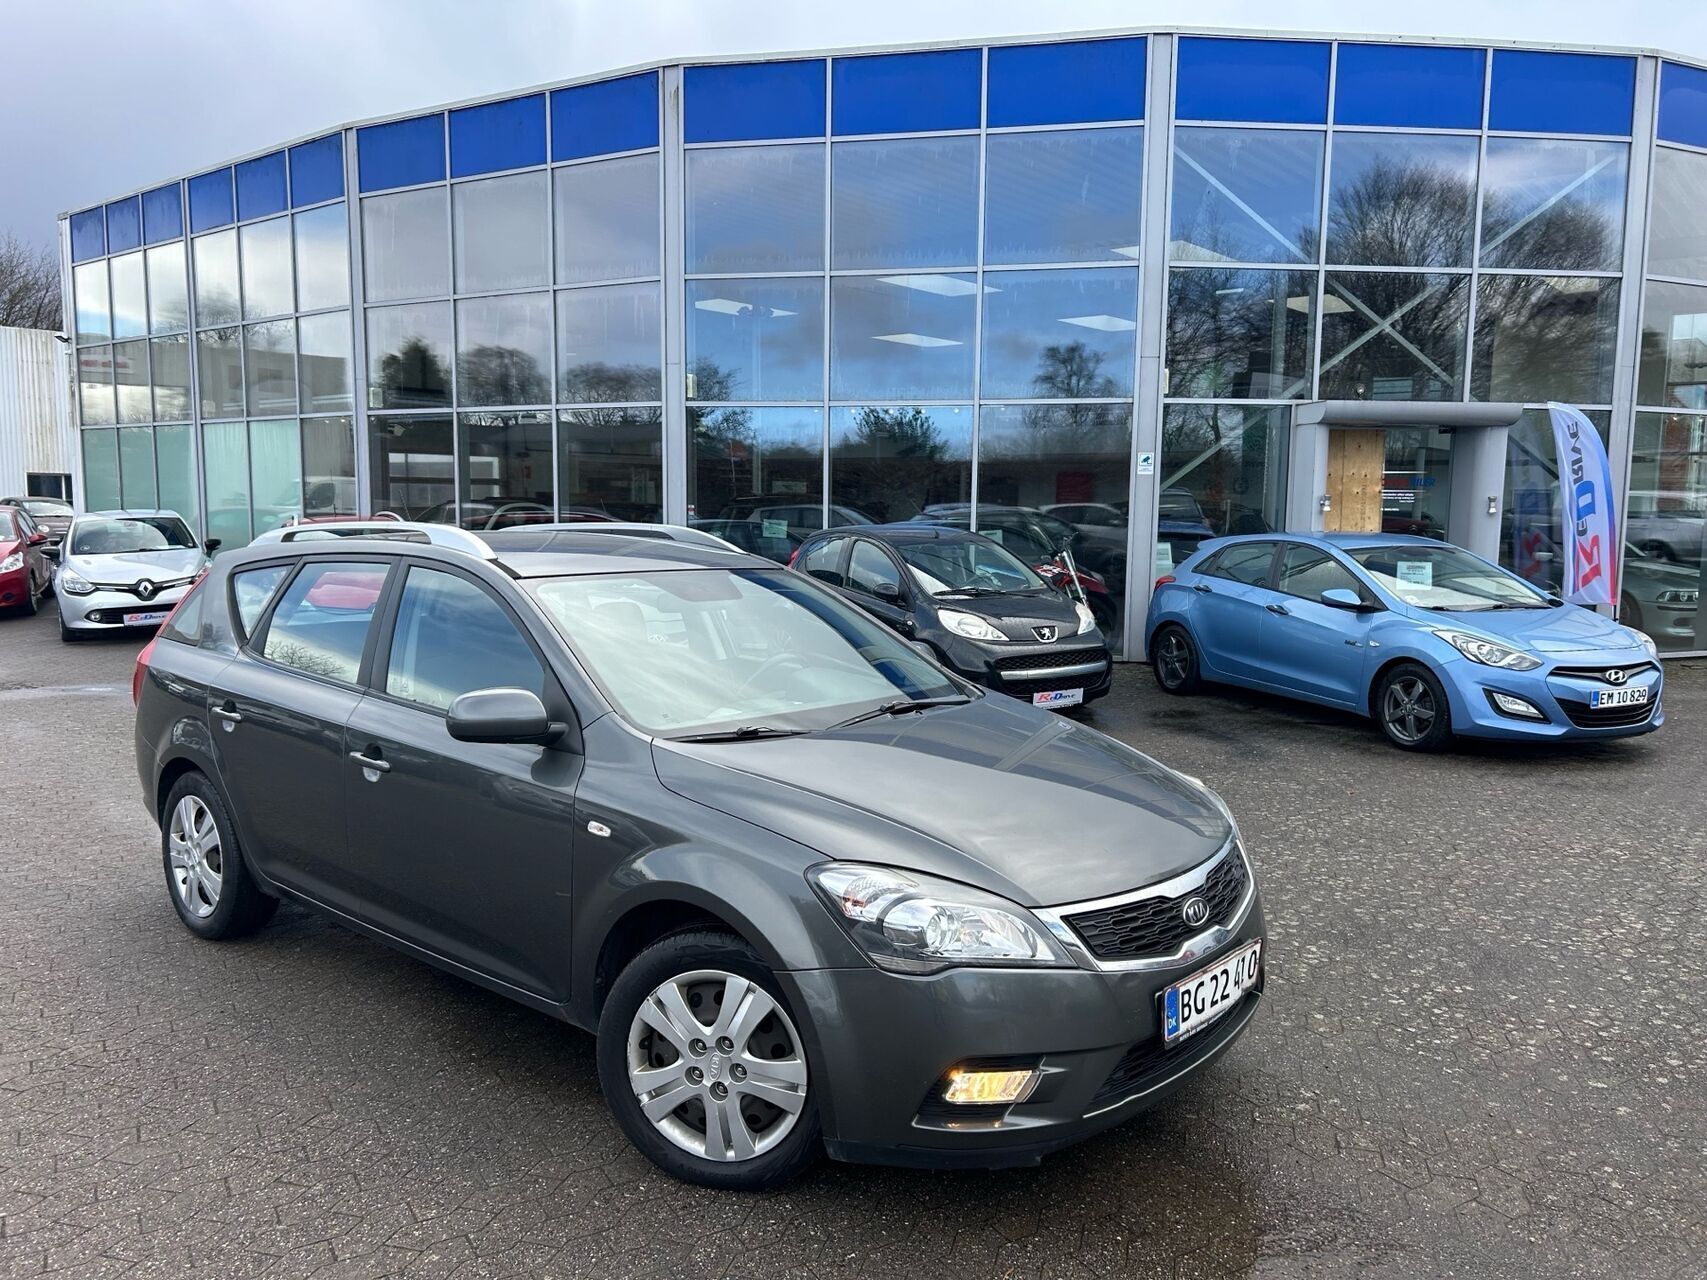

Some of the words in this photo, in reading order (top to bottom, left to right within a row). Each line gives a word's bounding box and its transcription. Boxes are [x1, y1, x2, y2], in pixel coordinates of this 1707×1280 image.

[1600, 692, 1614, 705] EM
[1617, 690, 1628, 703] 10
[1630, 688, 1647, 702] 829
[1181, 988, 1205, 1023] BG
[1210, 968, 1230, 1008] 22
[1168, 1016, 1177, 1030] DK
